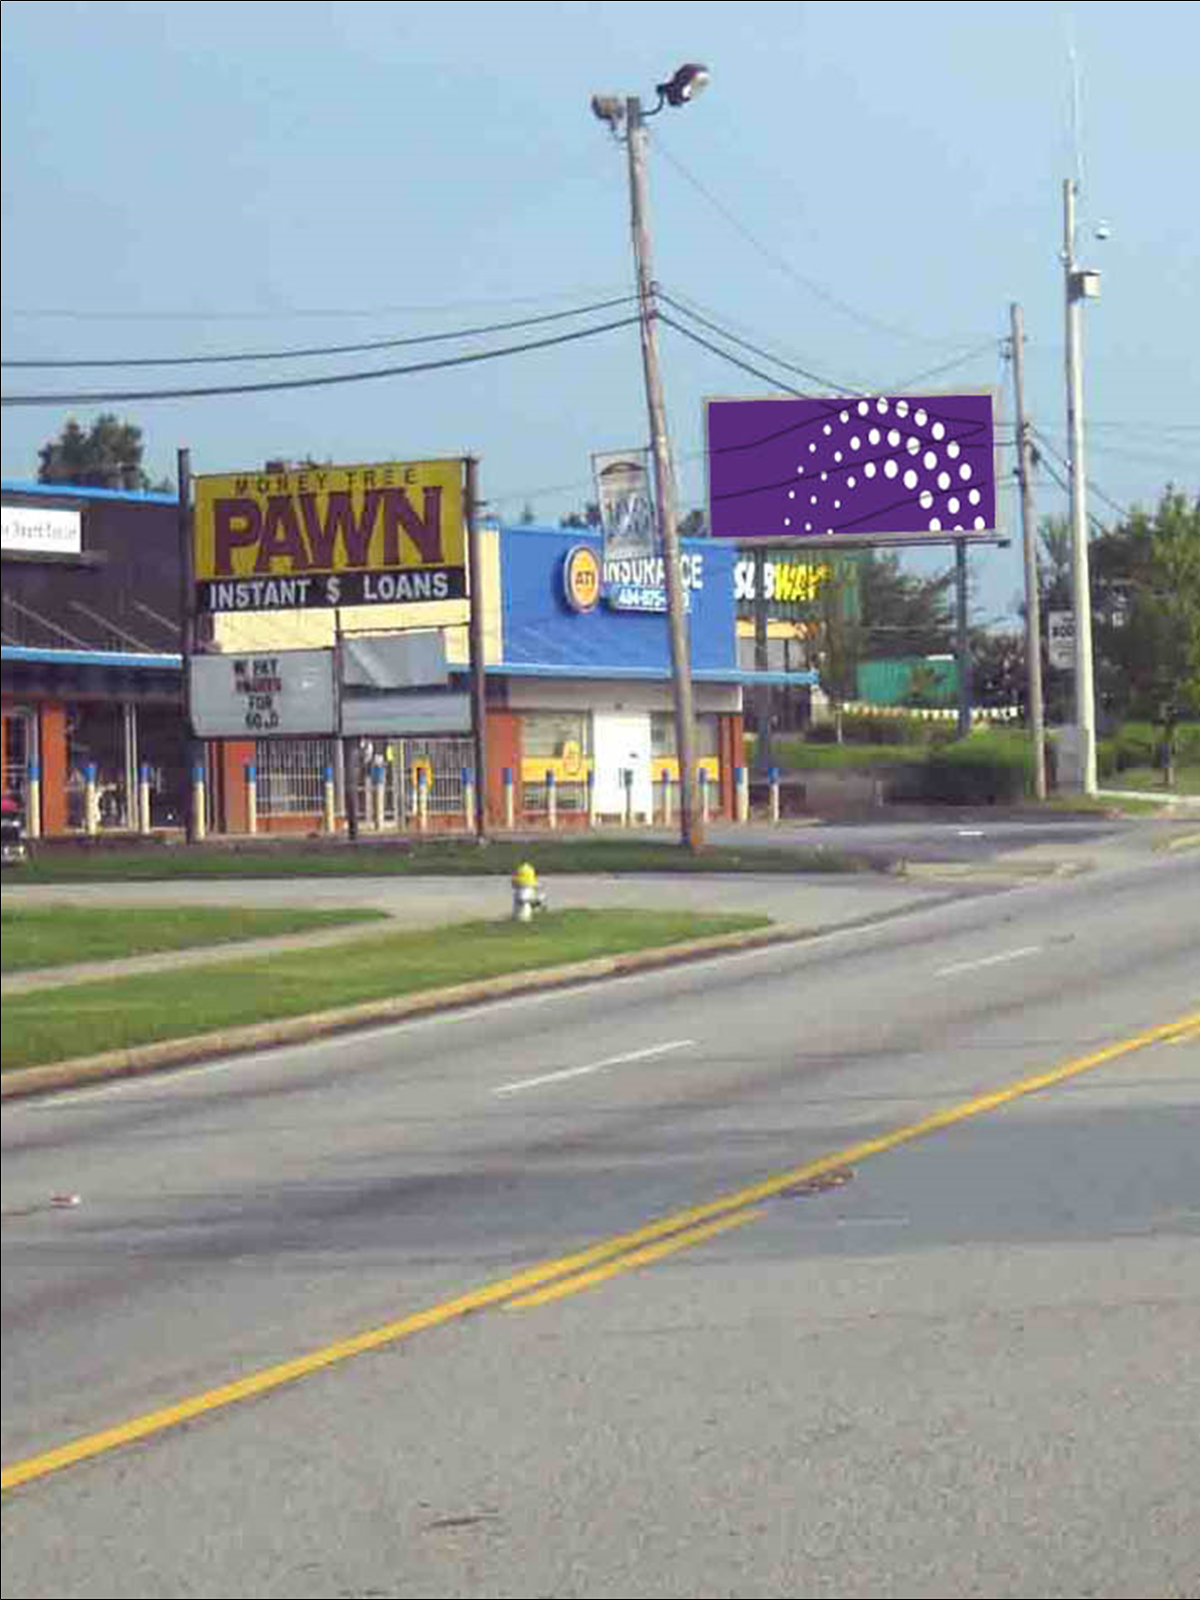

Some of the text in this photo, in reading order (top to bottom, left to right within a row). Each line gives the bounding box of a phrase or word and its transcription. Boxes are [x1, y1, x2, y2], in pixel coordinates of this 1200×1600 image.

[235, 468, 419, 495] MONEY TREE
[213, 486, 444, 576] PAWN
[603, 554, 703, 589] INSURACE
[210, 572, 448, 611] INSTANT $ LOANS
